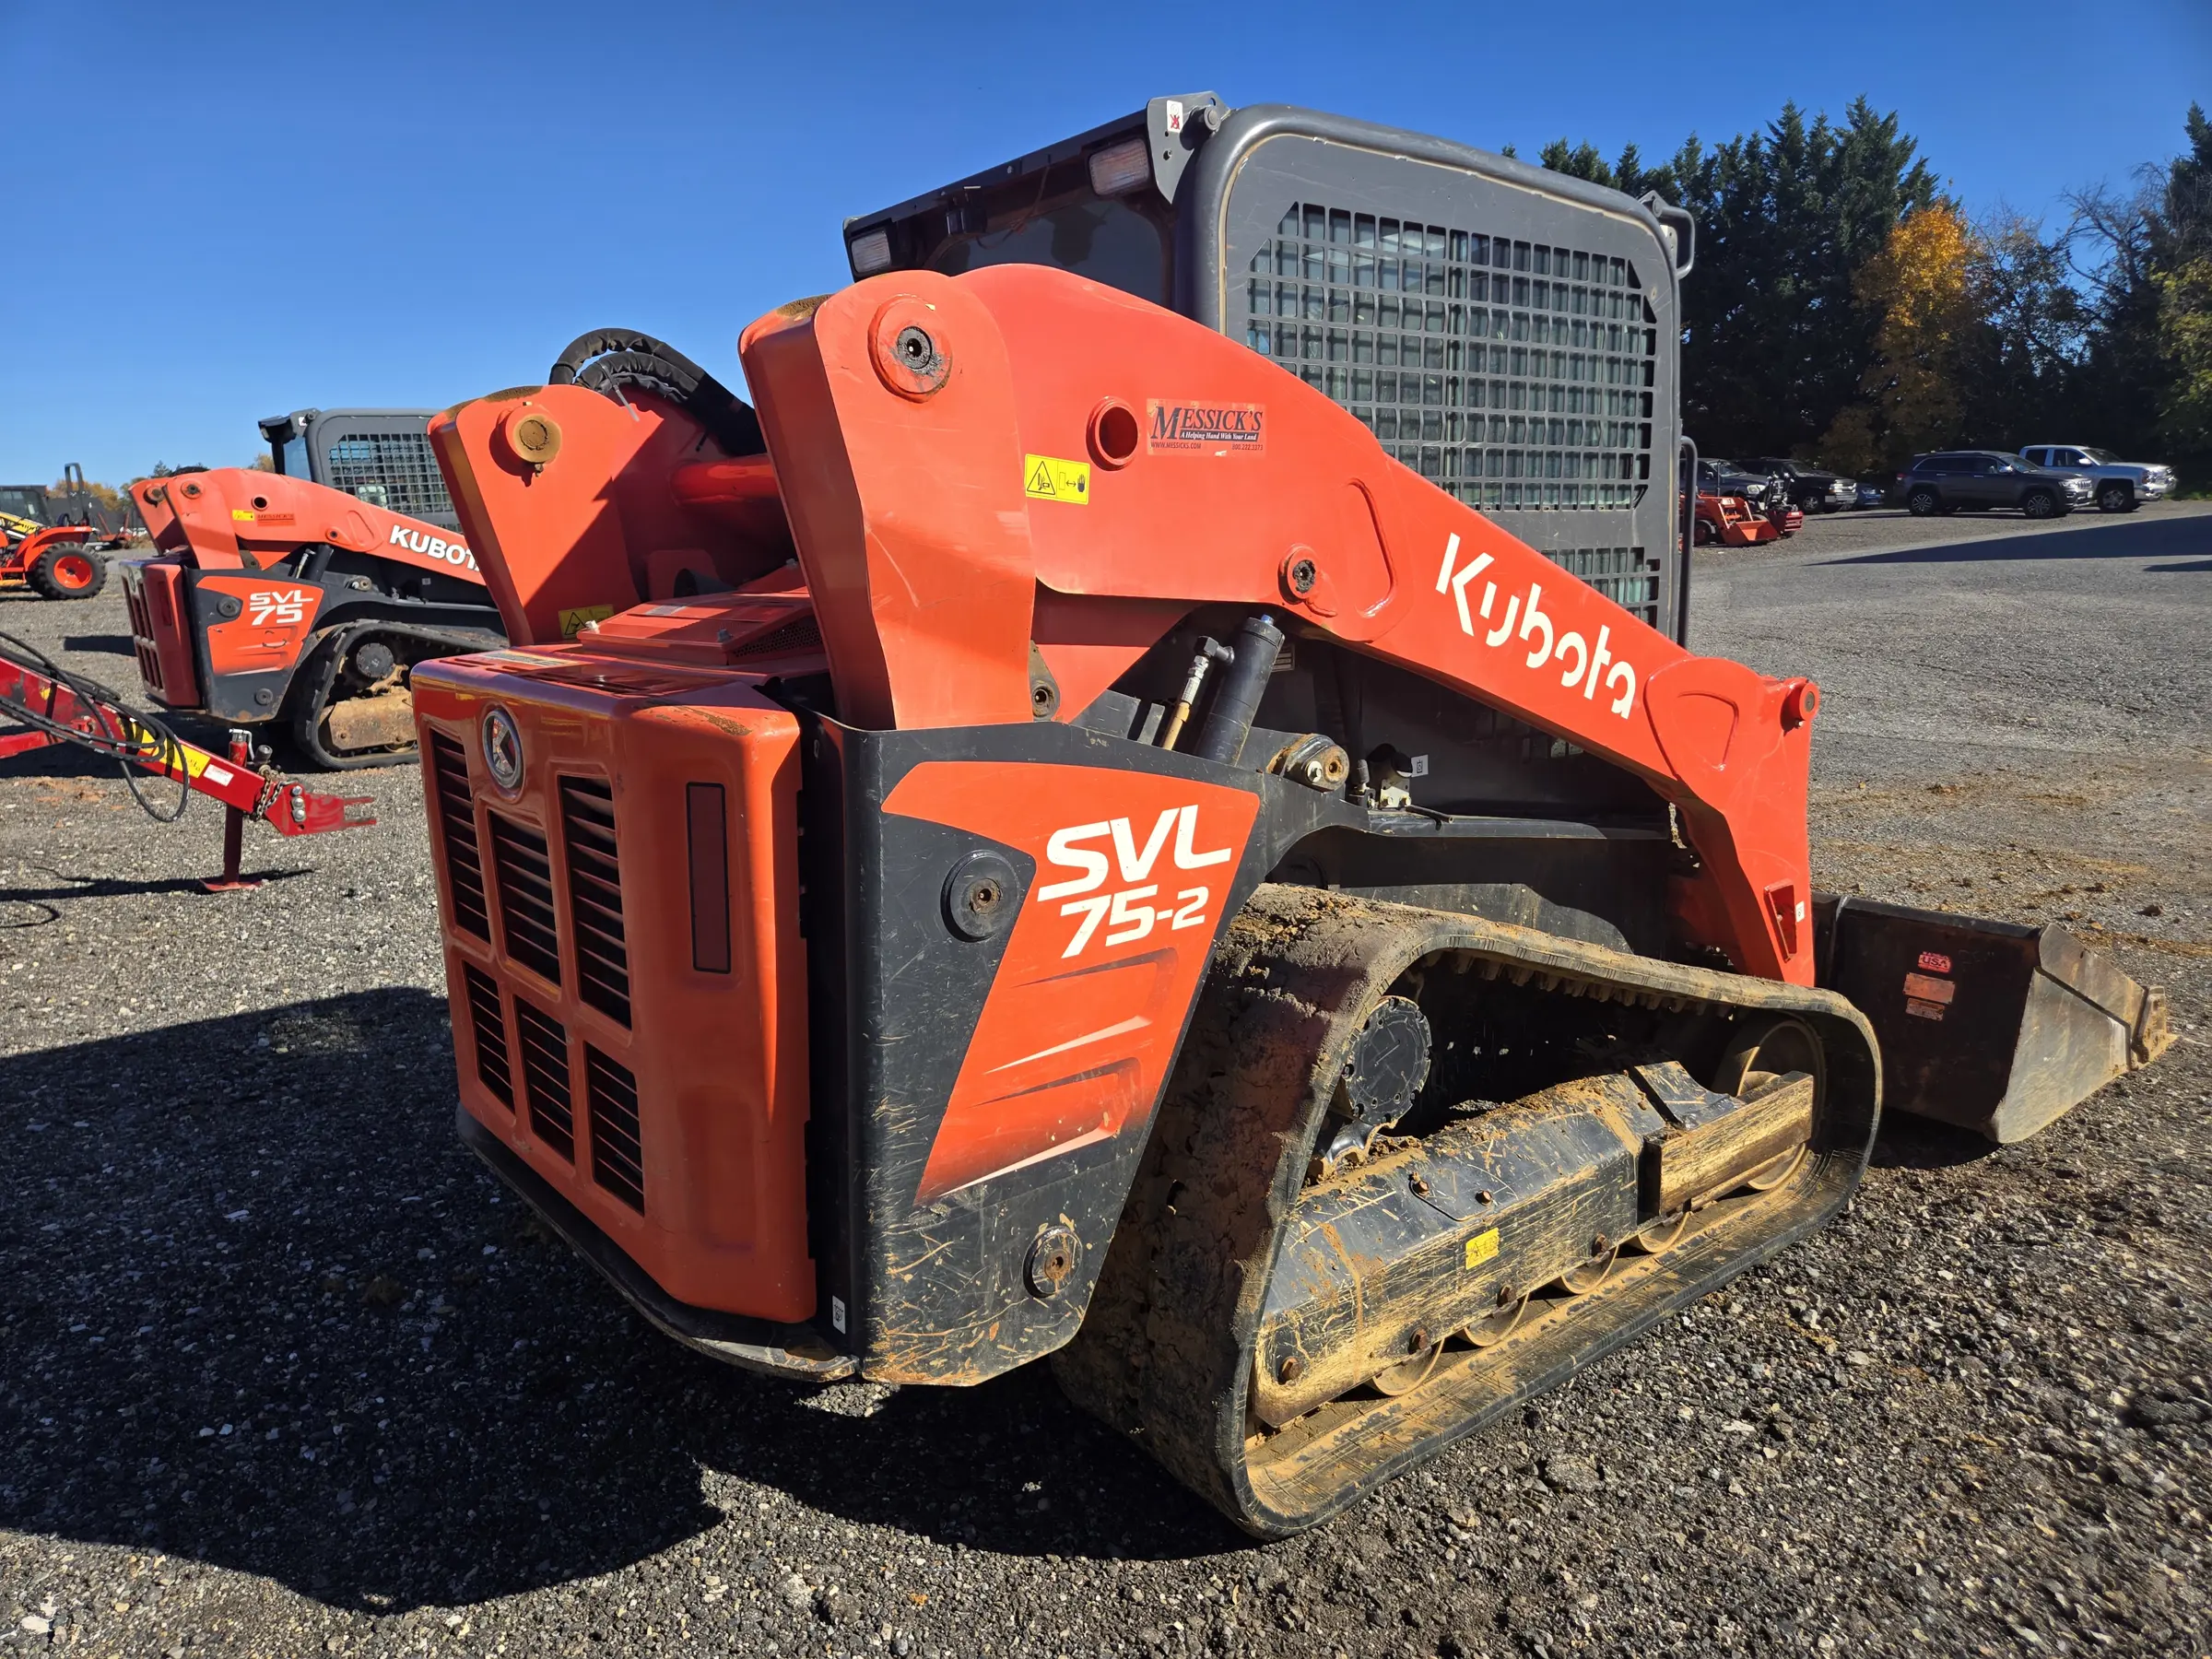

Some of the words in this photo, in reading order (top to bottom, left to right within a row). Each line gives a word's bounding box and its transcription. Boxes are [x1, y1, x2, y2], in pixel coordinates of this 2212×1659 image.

[1150, 406, 1264, 440] MESSICK'S
[1185, 431, 1206, 441] Helping
[1232, 432, 1244, 441] Your
[1151, 441, 1202, 450] WWW.MESSICKS.COM
[390, 524, 479, 571] KUBOT
[250, 590, 314, 606] SVL
[249, 603, 303, 626] 75
[1435, 532, 1636, 720] Kubota
[1037, 804, 1231, 902] SVL
[1060, 884, 1209, 959] 75-2
[1923, 956, 1947, 968] USA
